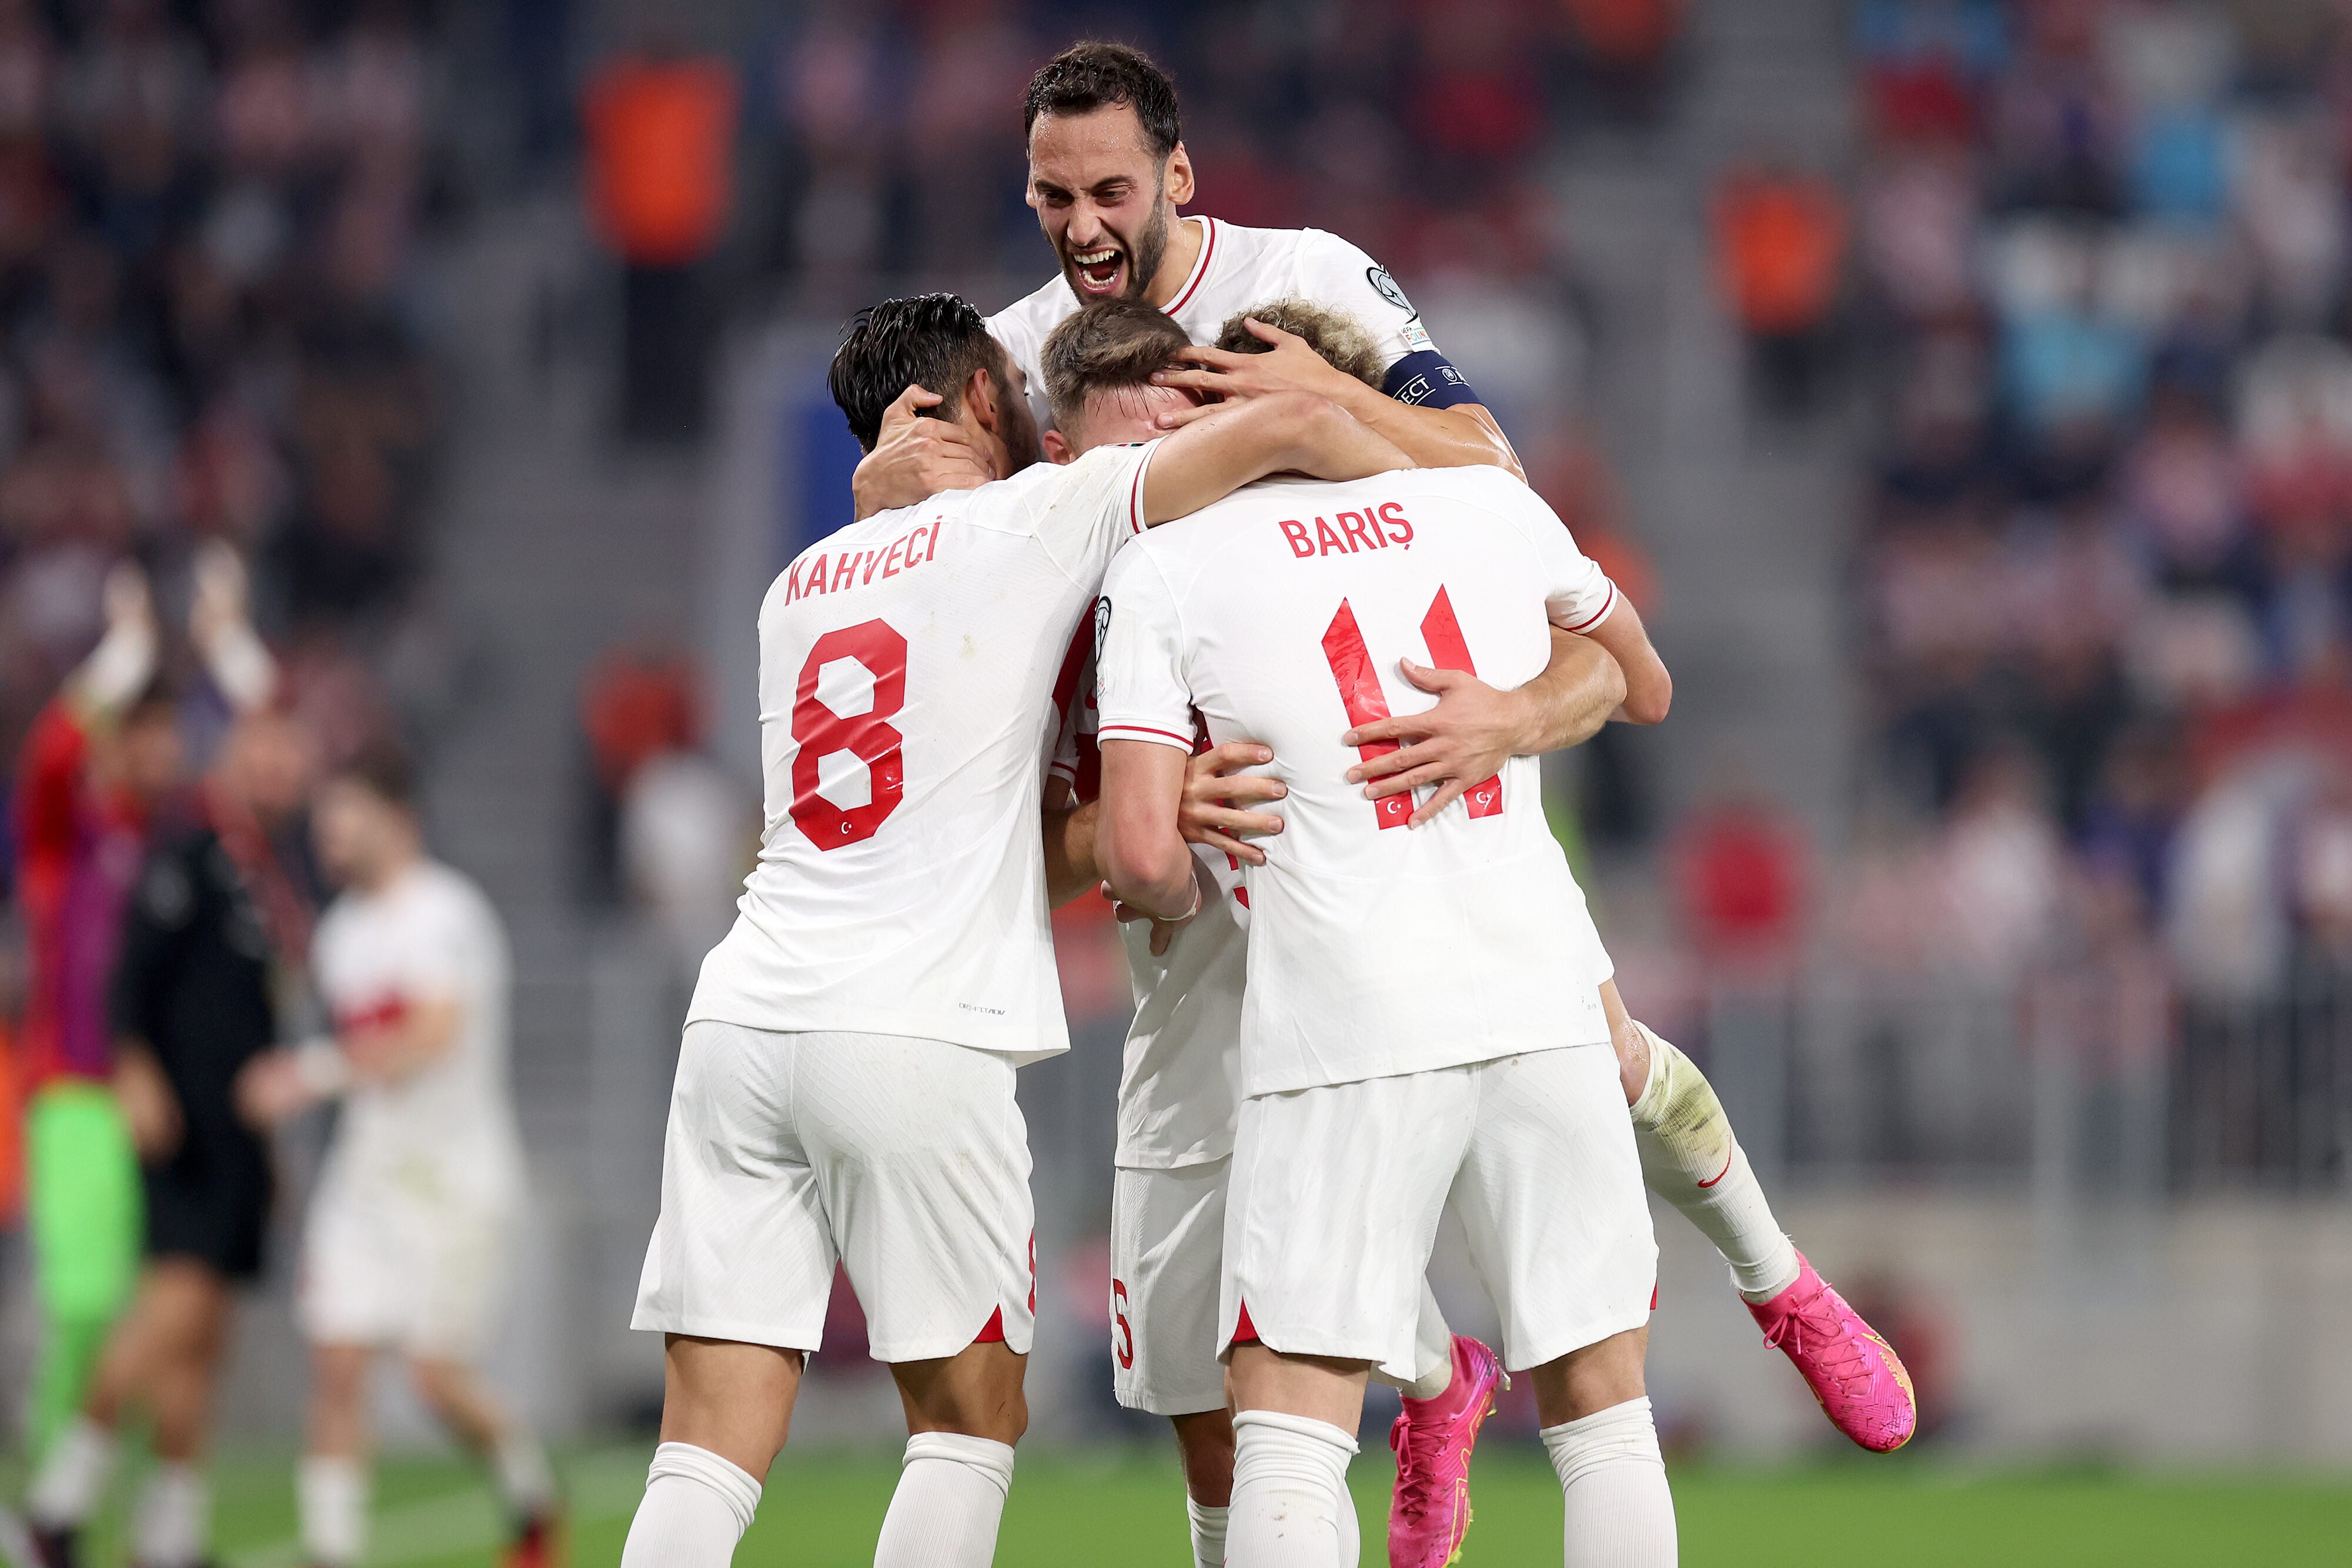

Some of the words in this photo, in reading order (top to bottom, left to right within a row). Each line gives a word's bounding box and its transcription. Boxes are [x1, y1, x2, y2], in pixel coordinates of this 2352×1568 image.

[1405, 330, 1429, 342] FOUN
[1398, 377, 1429, 405] ECT
[784, 515, 943, 607] KAHVECİ
[1278, 502, 1414, 558] BARIŞ
[789, 618, 907, 851] 8
[1321, 583, 1504, 830] 11
[1112, 1278, 1134, 1370] 5
